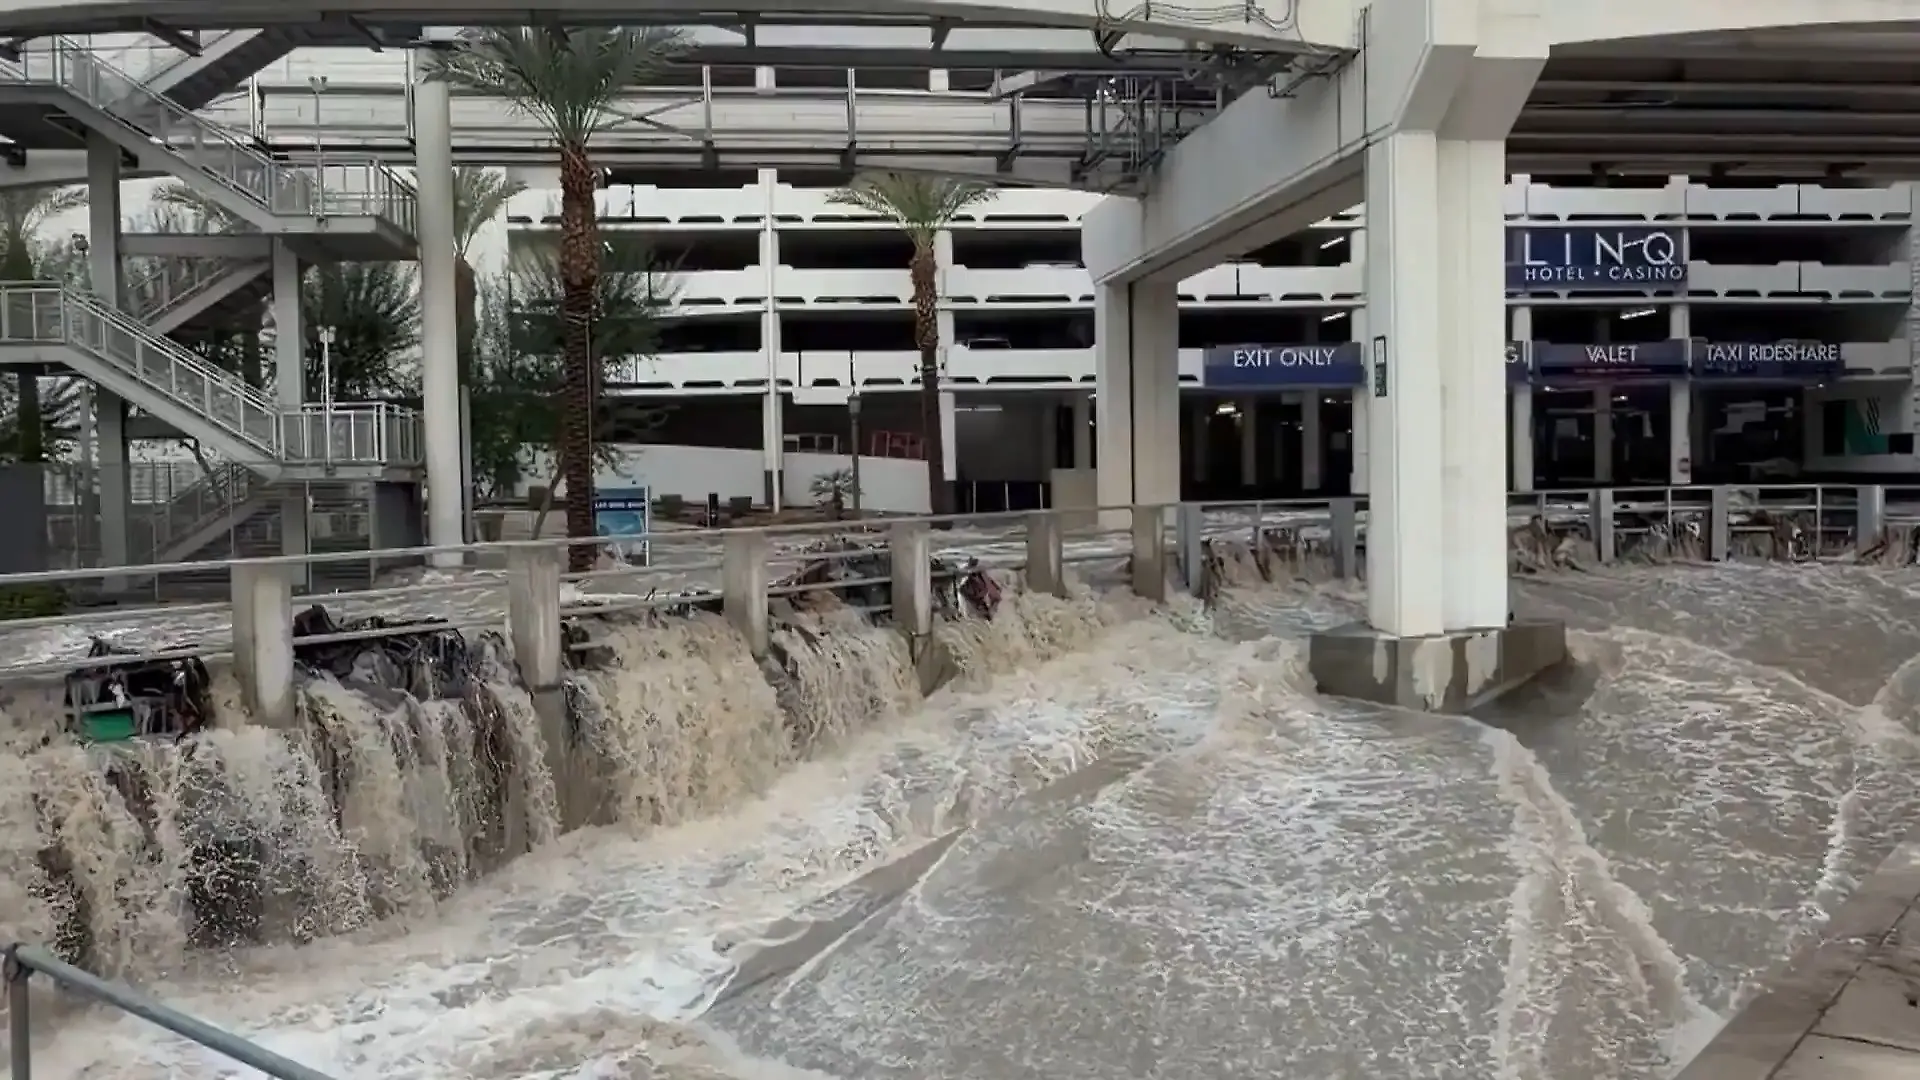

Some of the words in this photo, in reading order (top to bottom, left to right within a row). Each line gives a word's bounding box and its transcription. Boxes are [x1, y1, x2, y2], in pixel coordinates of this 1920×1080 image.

[1523, 231, 1676, 266] LINQ
[1524, 266, 1585, 281] HOTEL
[1608, 266, 1685, 281] CASINO
[1233, 349, 1273, 368] EXIT
[1279, 348, 1337, 367] ONLY
[1585, 344, 1639, 363] VALET
[1705, 344, 1742, 361] TAXI
[1749, 343, 1838, 361] RIDESHARE
